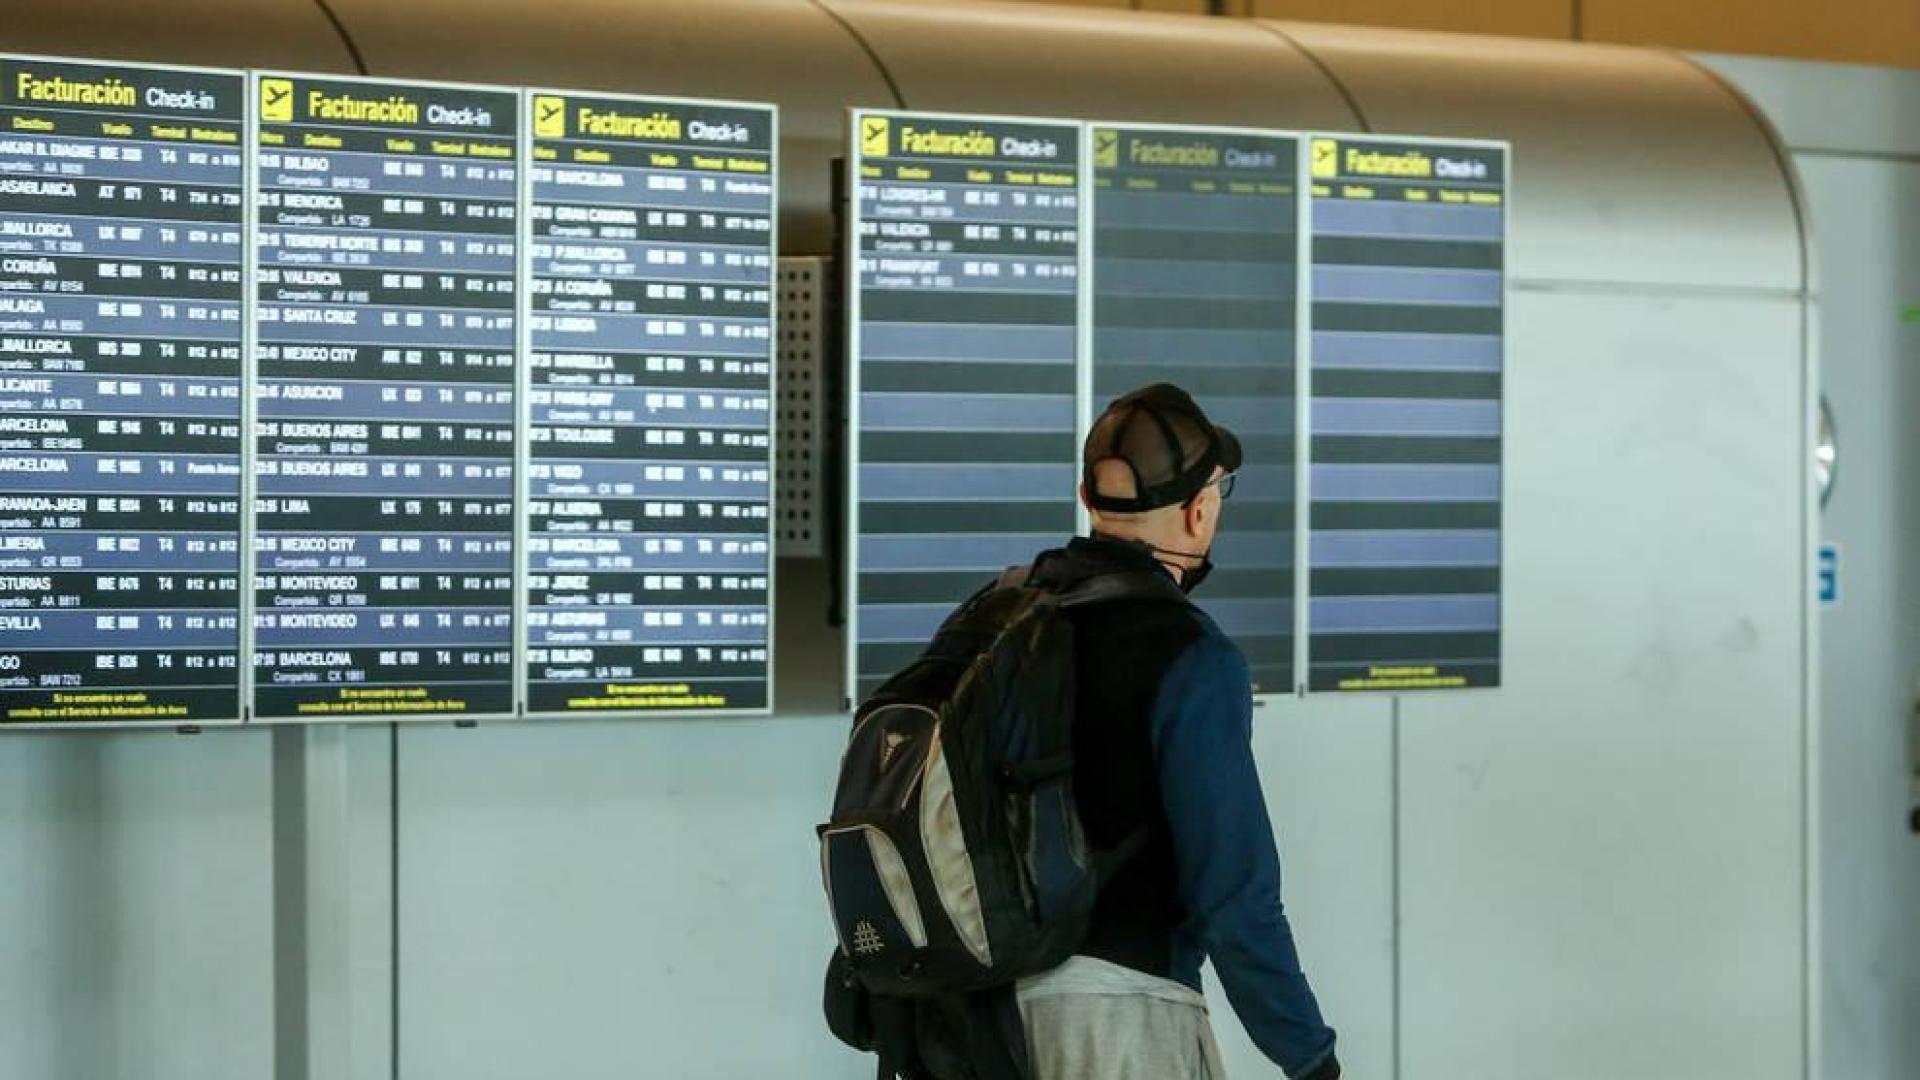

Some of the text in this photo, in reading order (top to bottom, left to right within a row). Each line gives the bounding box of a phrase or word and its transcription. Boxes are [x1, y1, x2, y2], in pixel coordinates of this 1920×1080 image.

[17, 72, 215, 110] Facturación Check-in
[309, 91, 491, 127] Facturación Check-in
[578, 107, 749, 142] Facturación Check-in
[0, 141, 34, 155] AKAR
[901, 126, 1057, 156] Facturación Check-in
[1346, 147, 1432, 177] Facturación
[0, 180, 76, 197] ASABLANCA
[159, 188, 176, 202] T4
[3, 256, 57, 275] CORUÑA
[159, 265, 176, 280] T4
[0, 299, 45, 313] ALAGA
[160, 303, 176, 318] T4
[159, 343, 175, 357] T4
[0, 378, 53, 393] LICANTE
[159, 382, 175, 397] T4
[0, 418, 68, 433] ARCELONA
[159, 421, 175, 435] T4
[0, 457, 68, 473] ARCELONA
[159, 459, 175, 474] T4
[0, 497, 87, 512] RANADA-JAEN
[158, 498, 174, 512] T4
[281, 500, 310, 513] LIMA
[0, 536, 45, 551] LMERIA
[158, 538, 174, 552] T4
[0, 576, 51, 591] STURIAS
[158, 577, 174, 591] T4
[281, 576, 357, 590] MONTEVIDEO
[0, 616, 42, 630] EVILLA
[157, 616, 173, 630] T4
[281, 614, 357, 628] MONTEVIDEO
[157, 655, 173, 668] T4
[280, 651, 351, 666] BARCELONA
